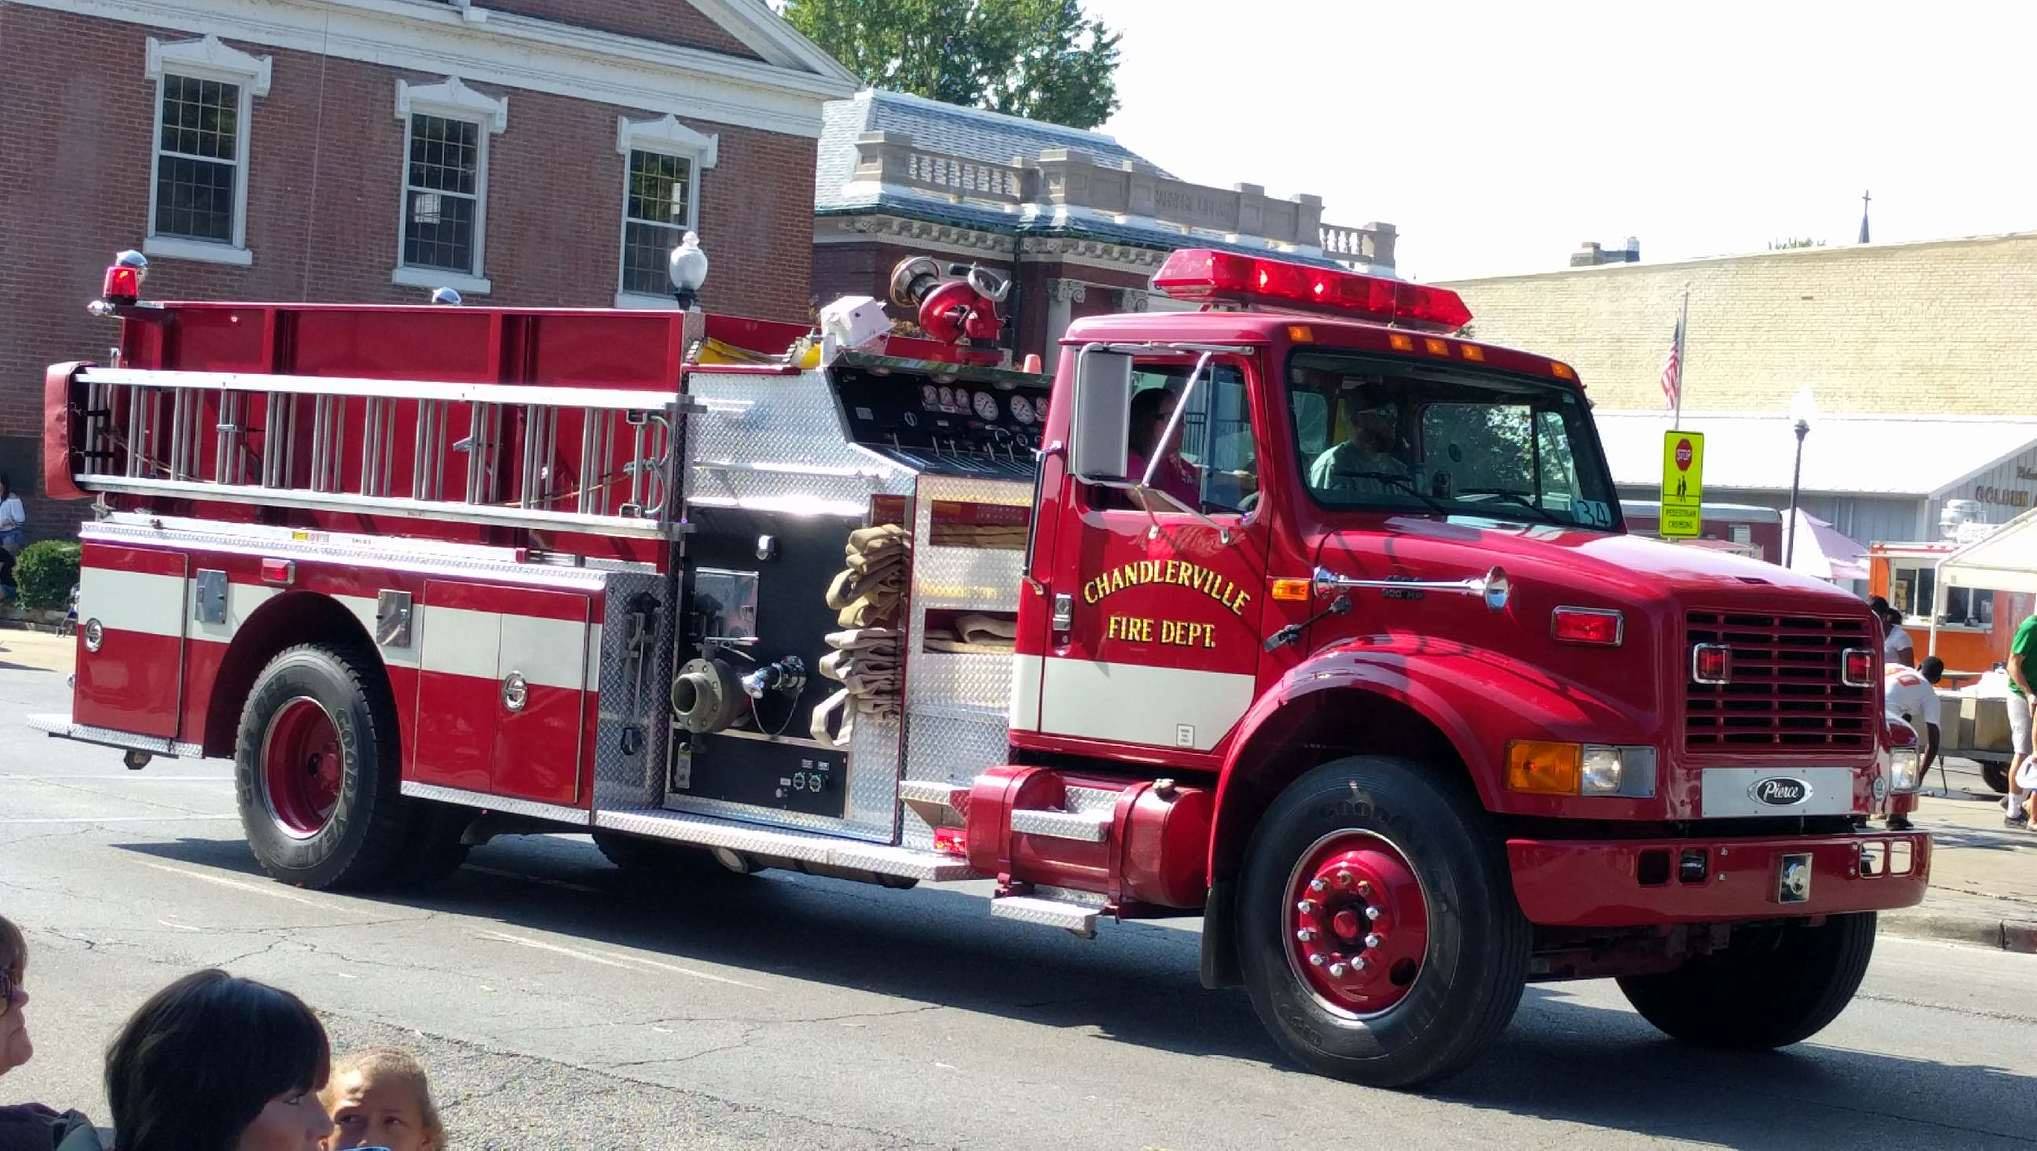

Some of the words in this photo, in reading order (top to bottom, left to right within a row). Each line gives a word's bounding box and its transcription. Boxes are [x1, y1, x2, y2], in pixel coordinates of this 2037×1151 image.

[1677, 448, 1691, 461] STOP
[1083, 559, 1251, 616] CHANDLERVILLE
[1109, 616, 1154, 642] FIRE
[1161, 619, 1216, 648] DEPT.
[1763, 780, 1799, 801] Pierce
